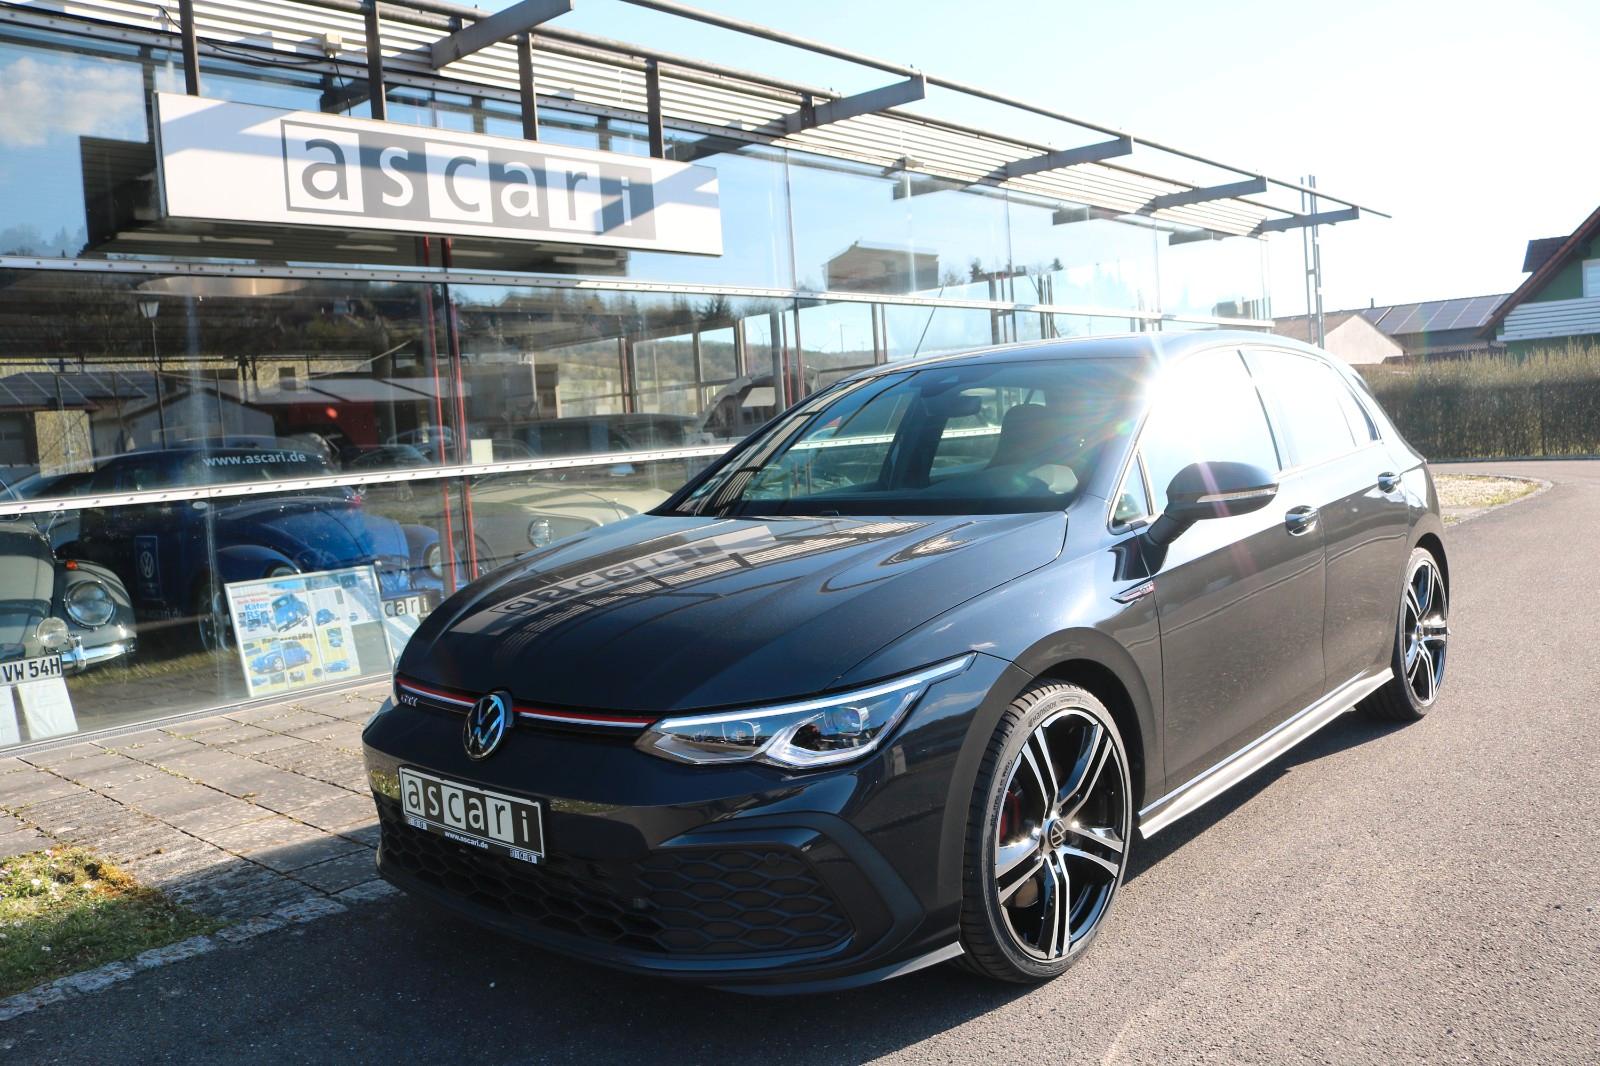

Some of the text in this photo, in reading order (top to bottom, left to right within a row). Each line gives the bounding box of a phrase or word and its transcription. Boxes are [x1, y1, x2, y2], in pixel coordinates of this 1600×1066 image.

[300, 136, 633, 228] ascari
[201, 450, 307, 467] www.ascari.de
[3, 657, 61, 682] VW 54H
[407, 779, 529, 843] ascari
[444, 830, 489, 850] www.ascari.de
